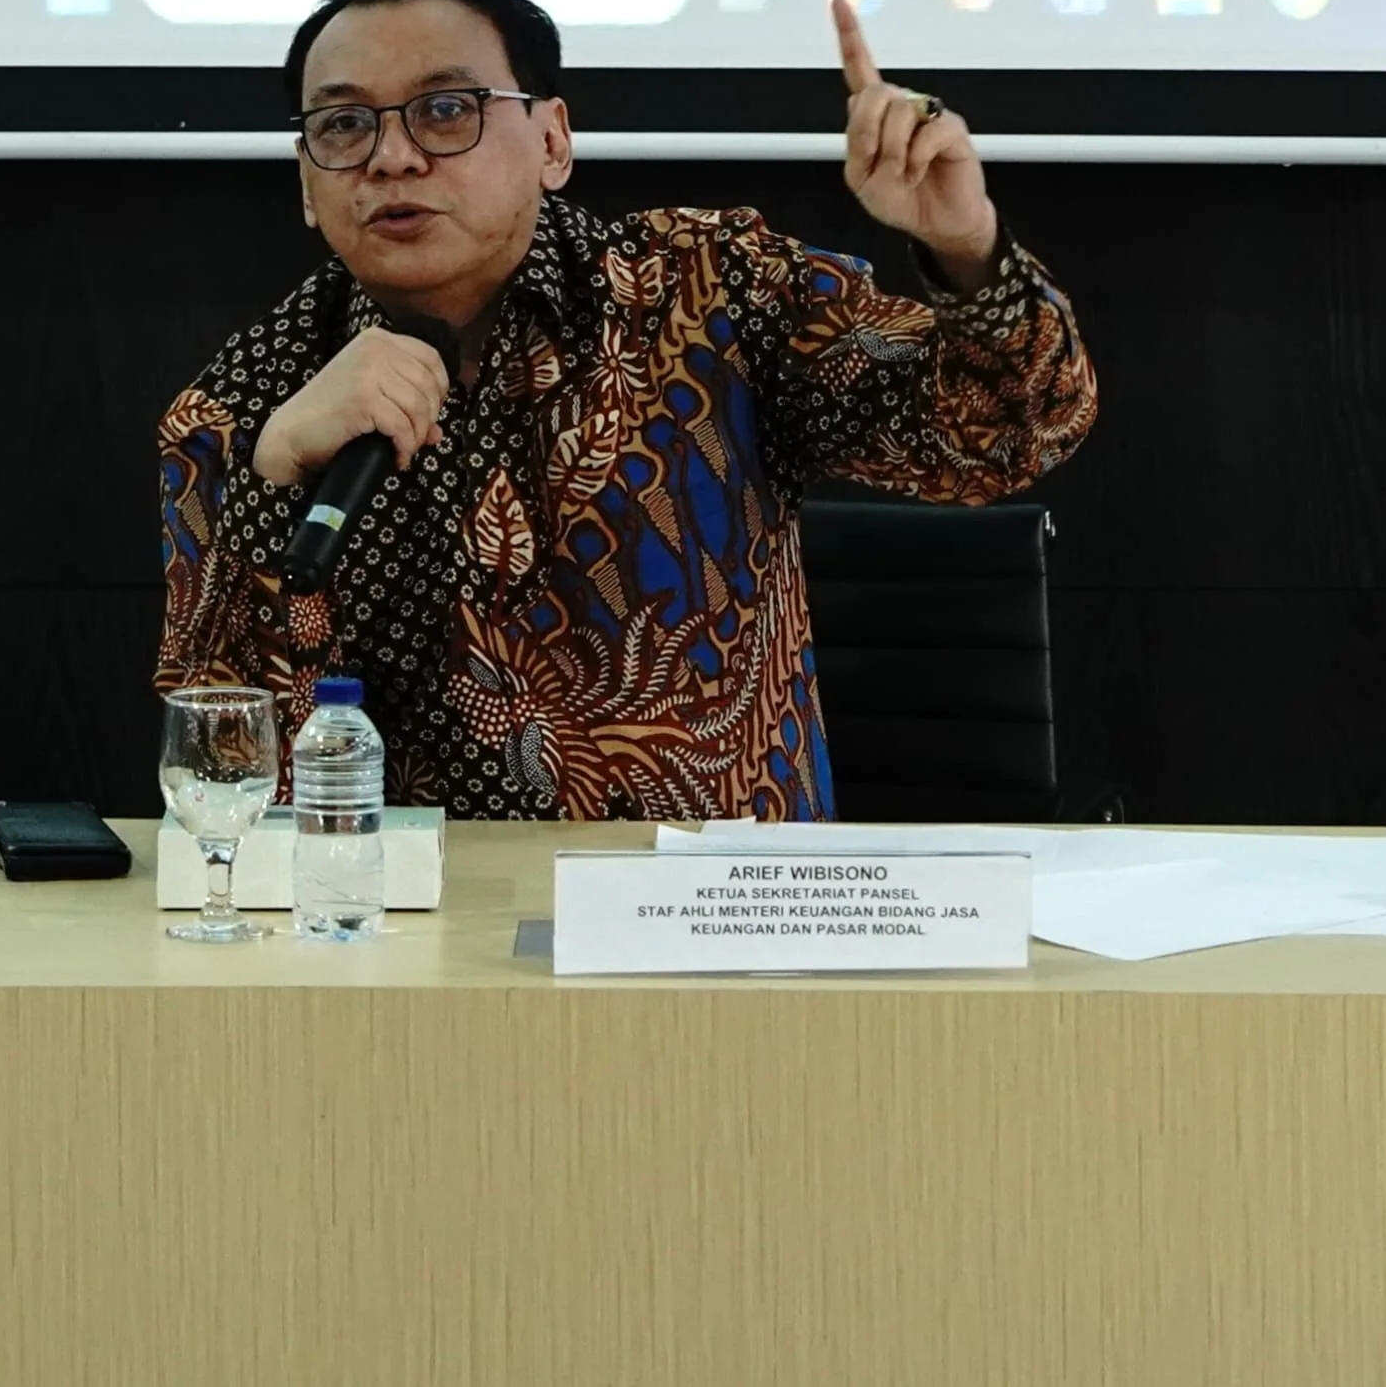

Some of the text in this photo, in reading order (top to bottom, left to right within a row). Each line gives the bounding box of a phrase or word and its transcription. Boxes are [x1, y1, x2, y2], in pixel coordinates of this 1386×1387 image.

[728, 865, 888, 881] ARIEF WIBISONO
[696, 887, 919, 901] KETUA SEKRETARIAT PANSEL
[637, 905, 980, 919] STAF AHLI MENTERI KEUANGAN BIDANG JASA
[691, 923, 925, 936] KEUANGAN DAN PASAR MODAL
